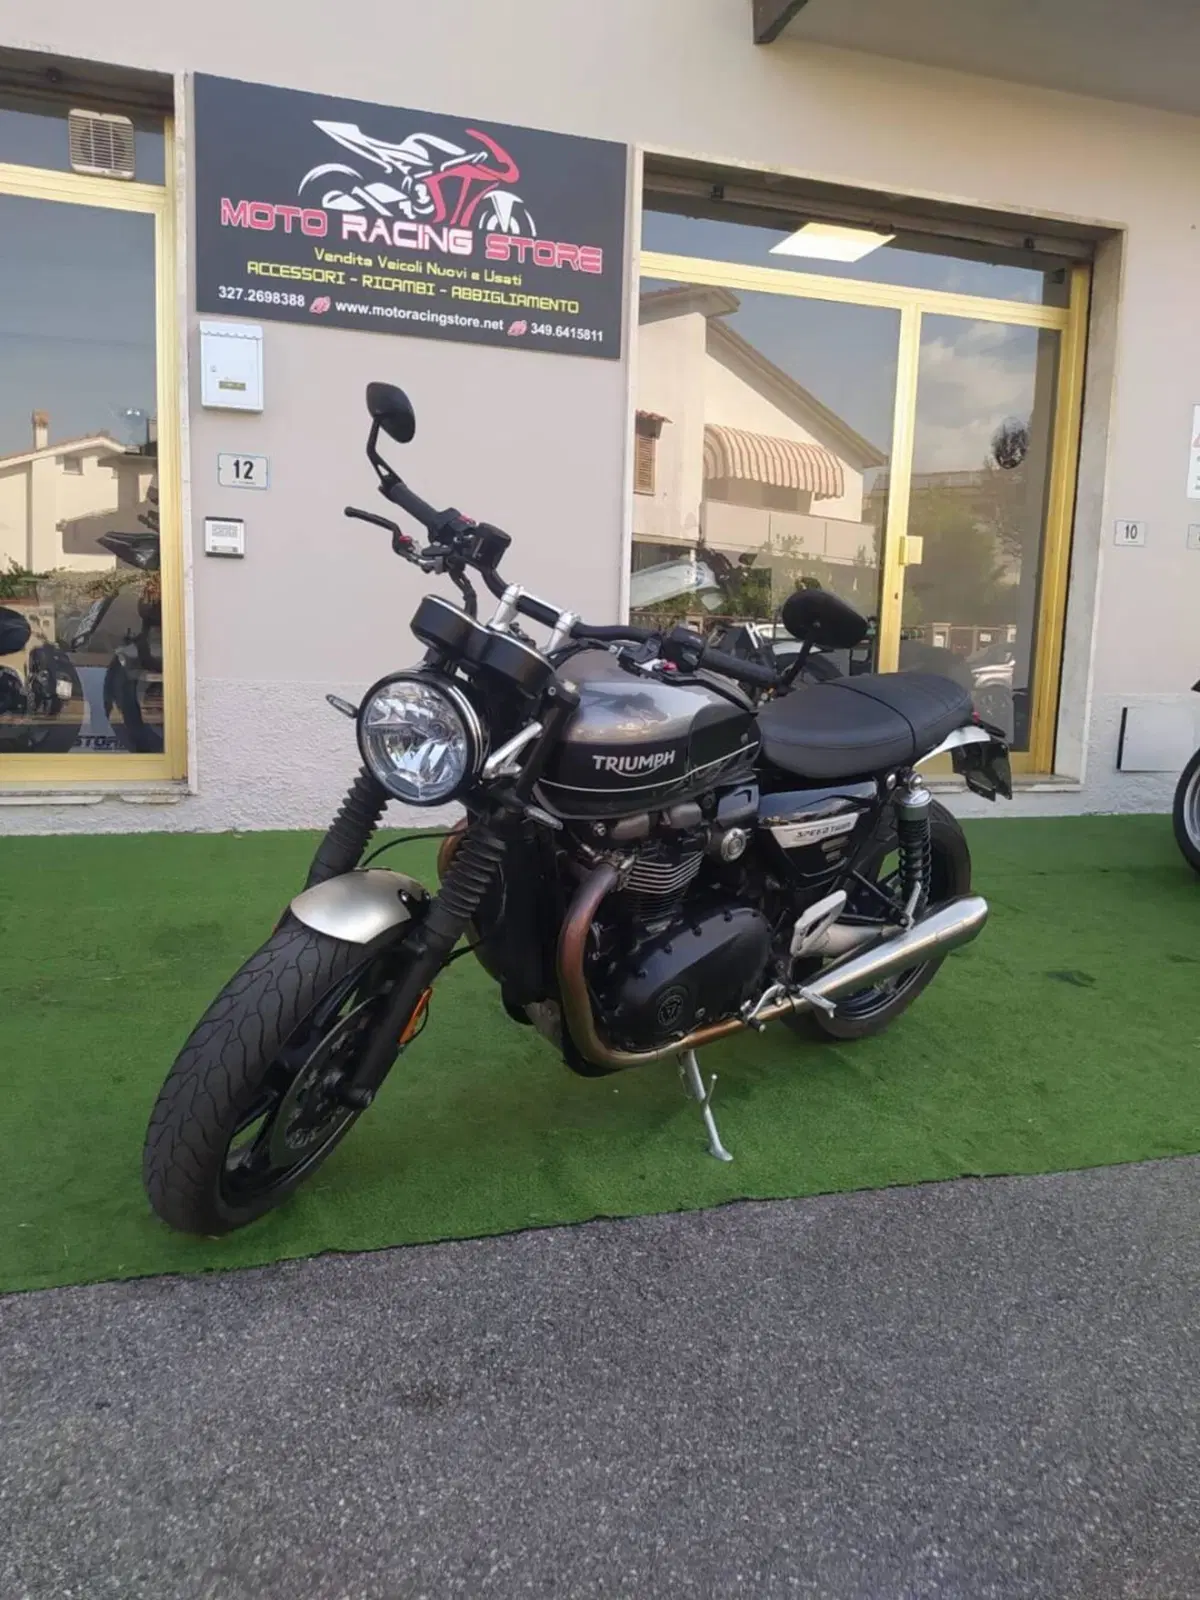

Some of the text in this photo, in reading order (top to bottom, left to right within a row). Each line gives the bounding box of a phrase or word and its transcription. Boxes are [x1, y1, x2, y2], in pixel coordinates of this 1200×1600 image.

[221, 197, 603, 274] MOTO RACING STORE
[314, 247, 522, 287] Vendita Veicoli Nuovi e Usati
[246, 261, 346, 285] ACCESSORI
[362, 274, 436, 296] RICAMBI
[451, 286, 580, 314] ABBIGLIAMENTO
[218, 285, 604, 342] 327.2698388 www.motoracingstore.net 349.6415811
[233, 459, 254, 480] 12
[1124, 524, 1138, 539] 10
[592, 750, 676, 777] TRIUMPH
